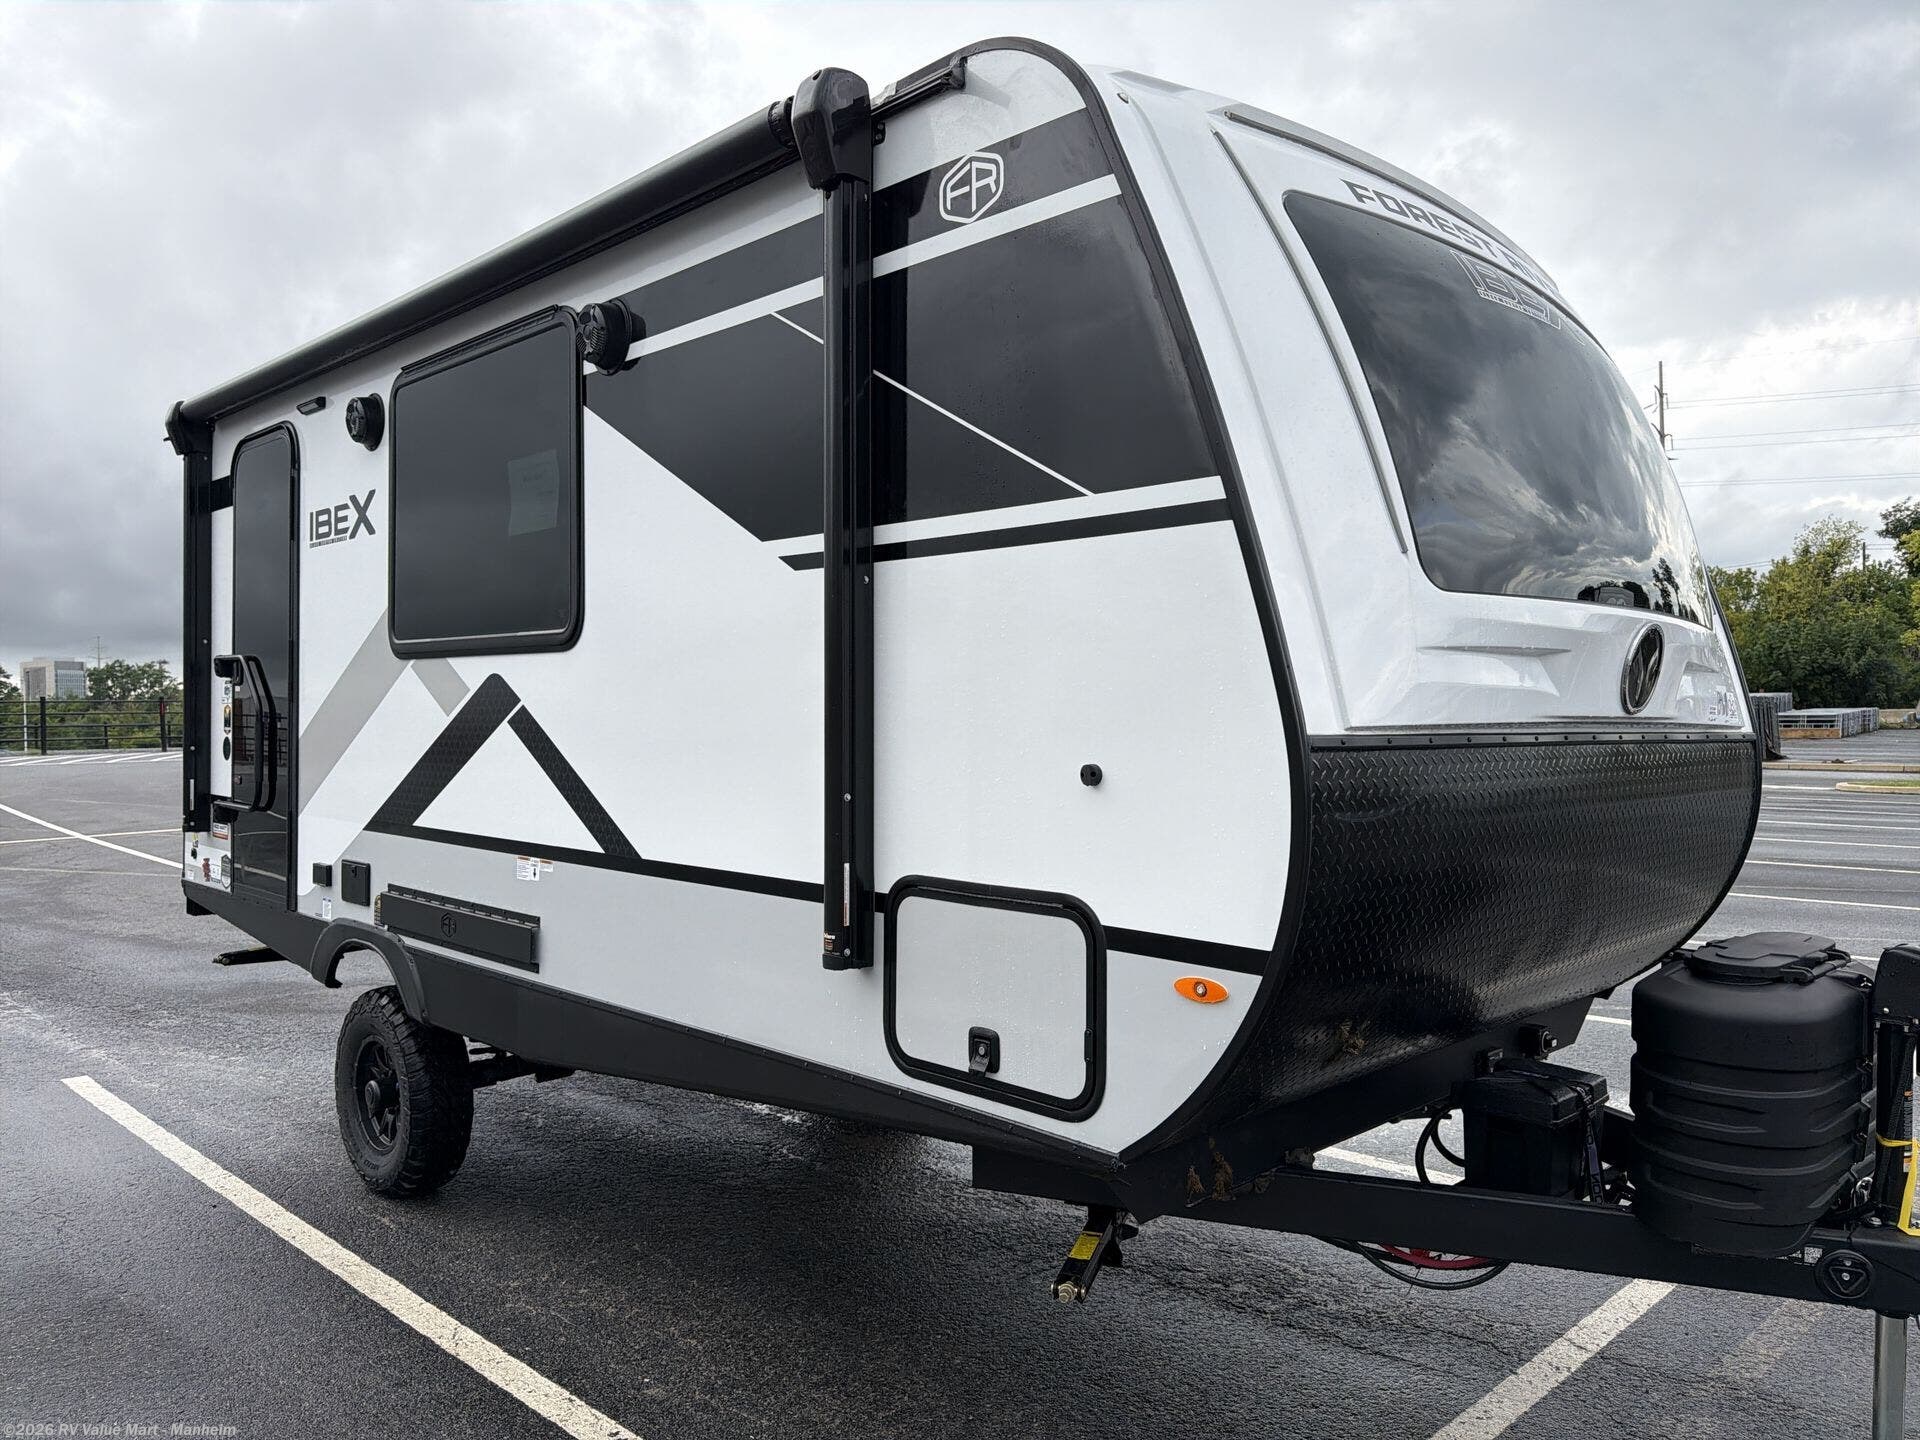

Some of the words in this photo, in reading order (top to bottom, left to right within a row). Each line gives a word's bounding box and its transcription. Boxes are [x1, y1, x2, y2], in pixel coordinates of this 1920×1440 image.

[944, 159, 998, 214] FR
[1340, 178, 1499, 259] FOREST
[309, 488, 377, 542] IBEX
